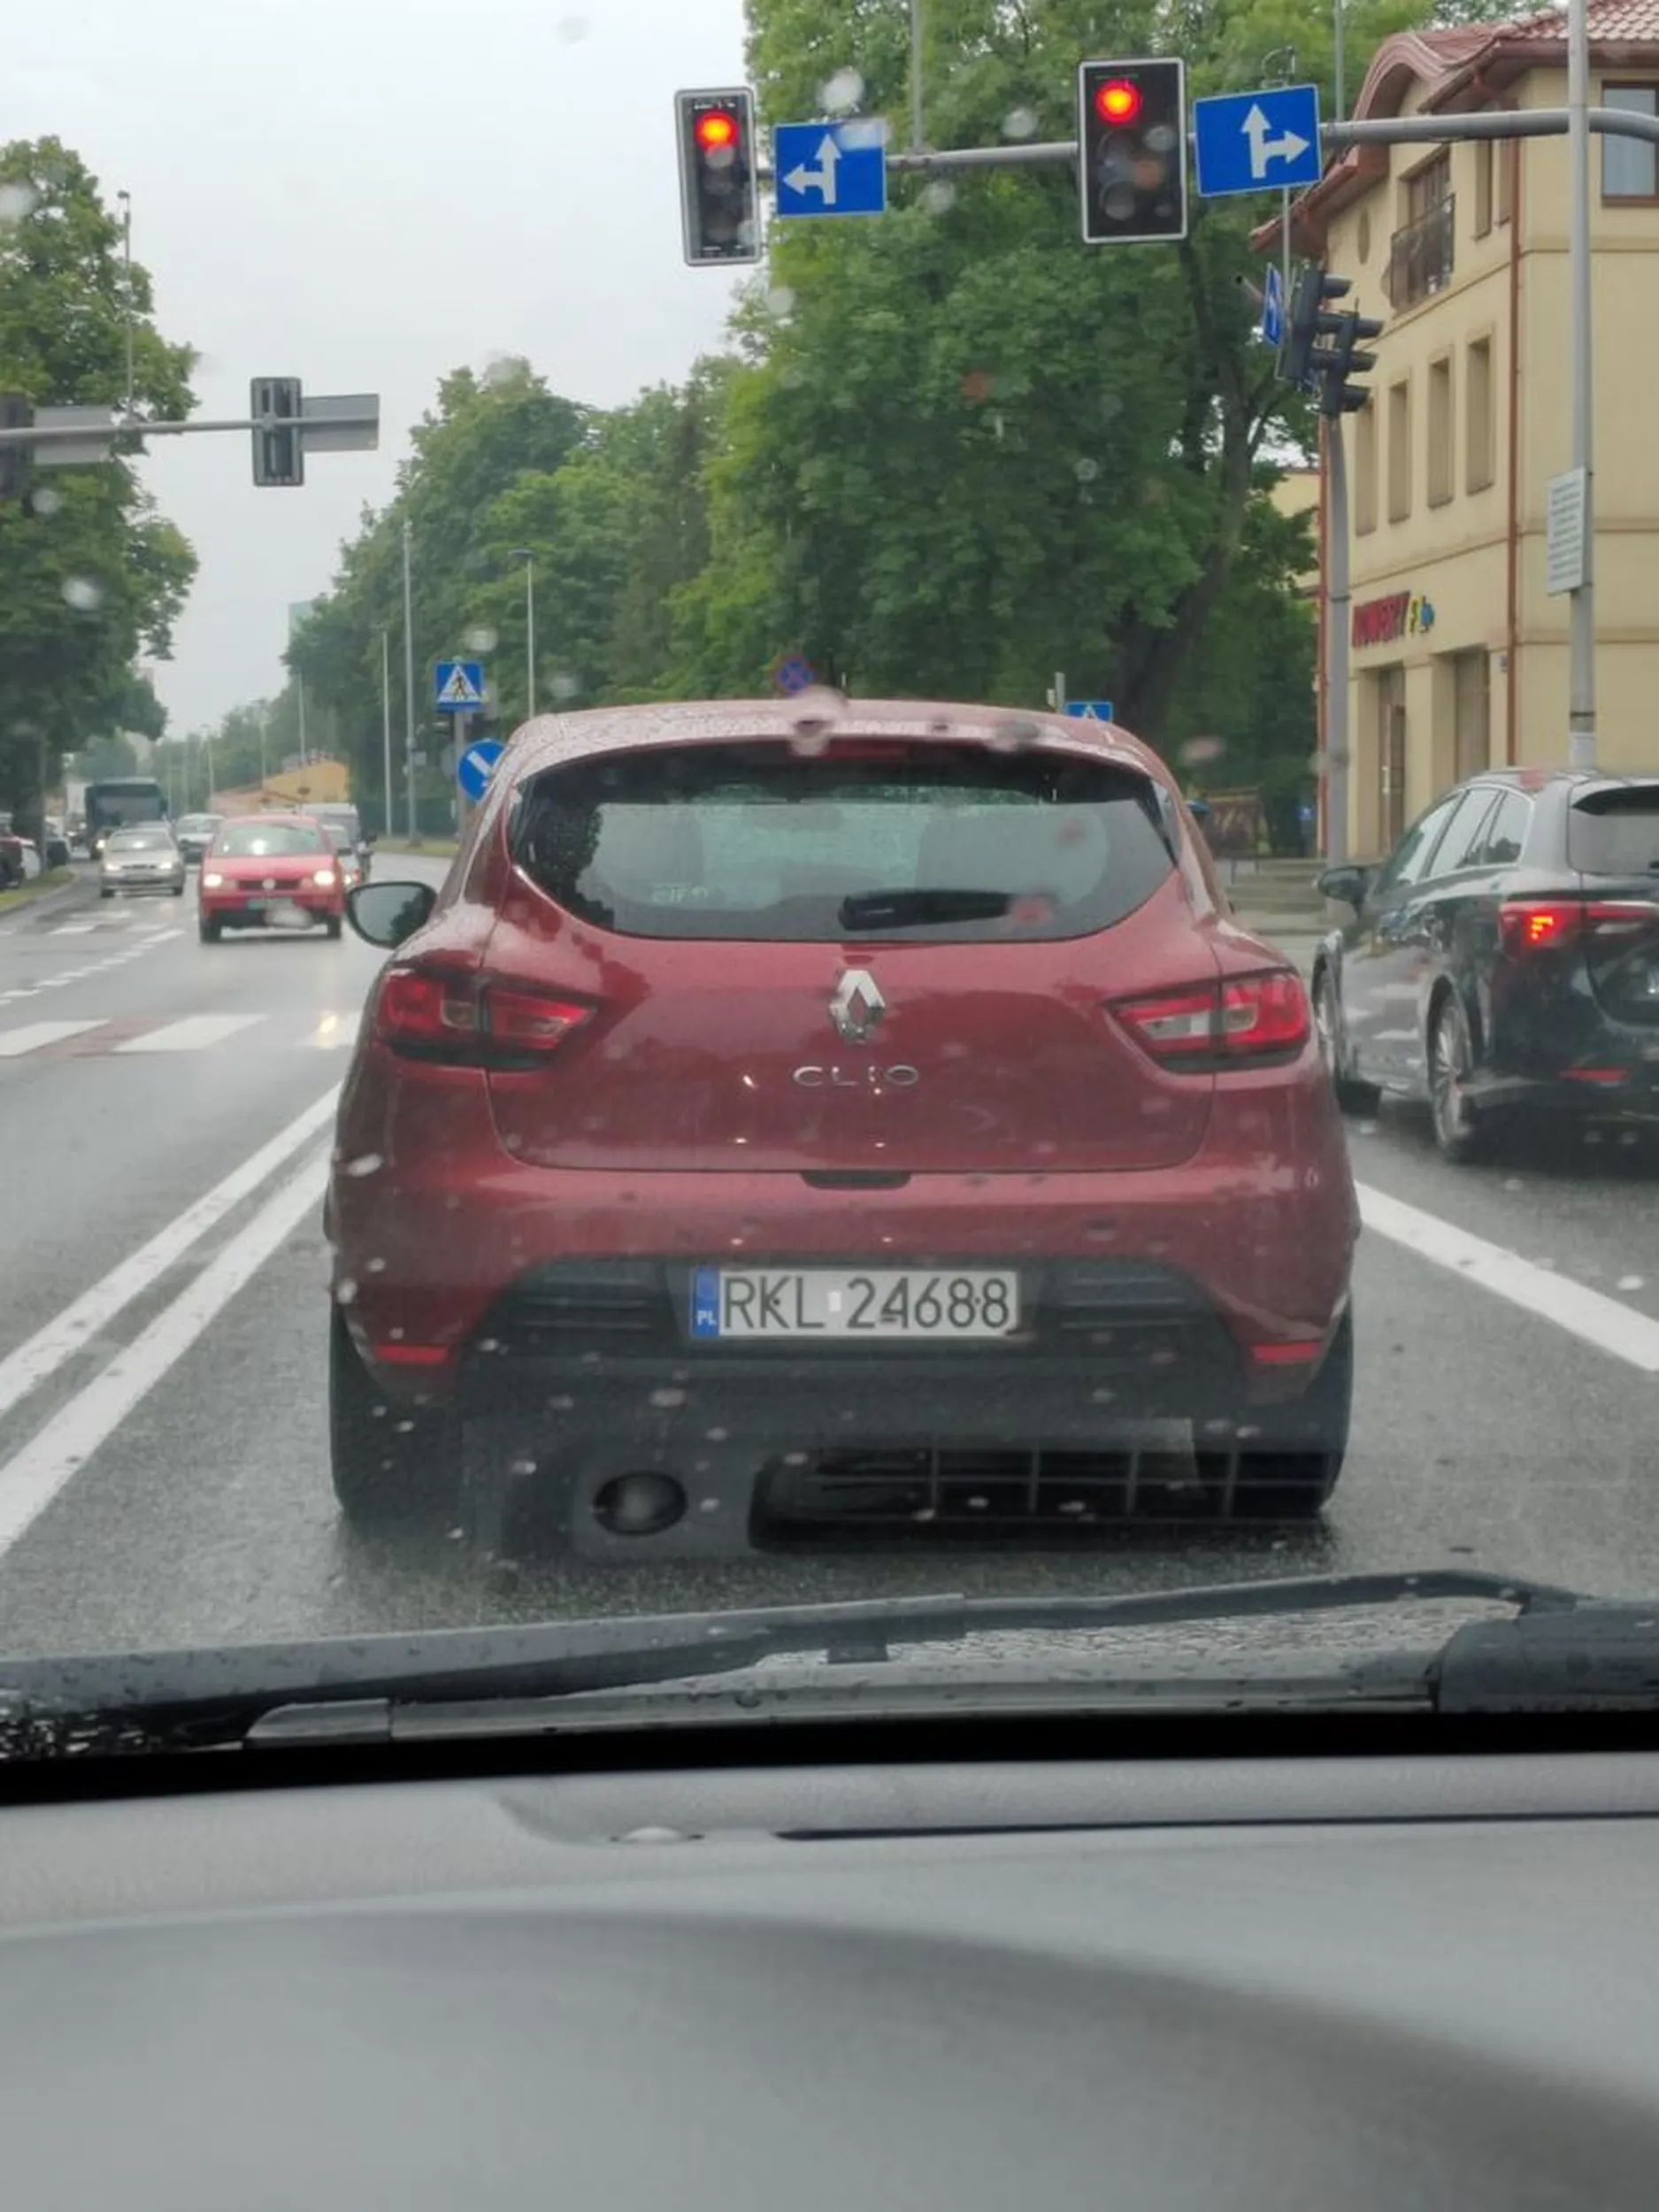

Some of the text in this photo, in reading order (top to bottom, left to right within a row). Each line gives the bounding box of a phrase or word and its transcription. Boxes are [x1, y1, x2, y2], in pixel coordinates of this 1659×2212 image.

[793, 1064, 919, 1087] CLIO
[724, 1275, 1010, 1330] RKL 24688
[695, 1310, 718, 1326] PL
